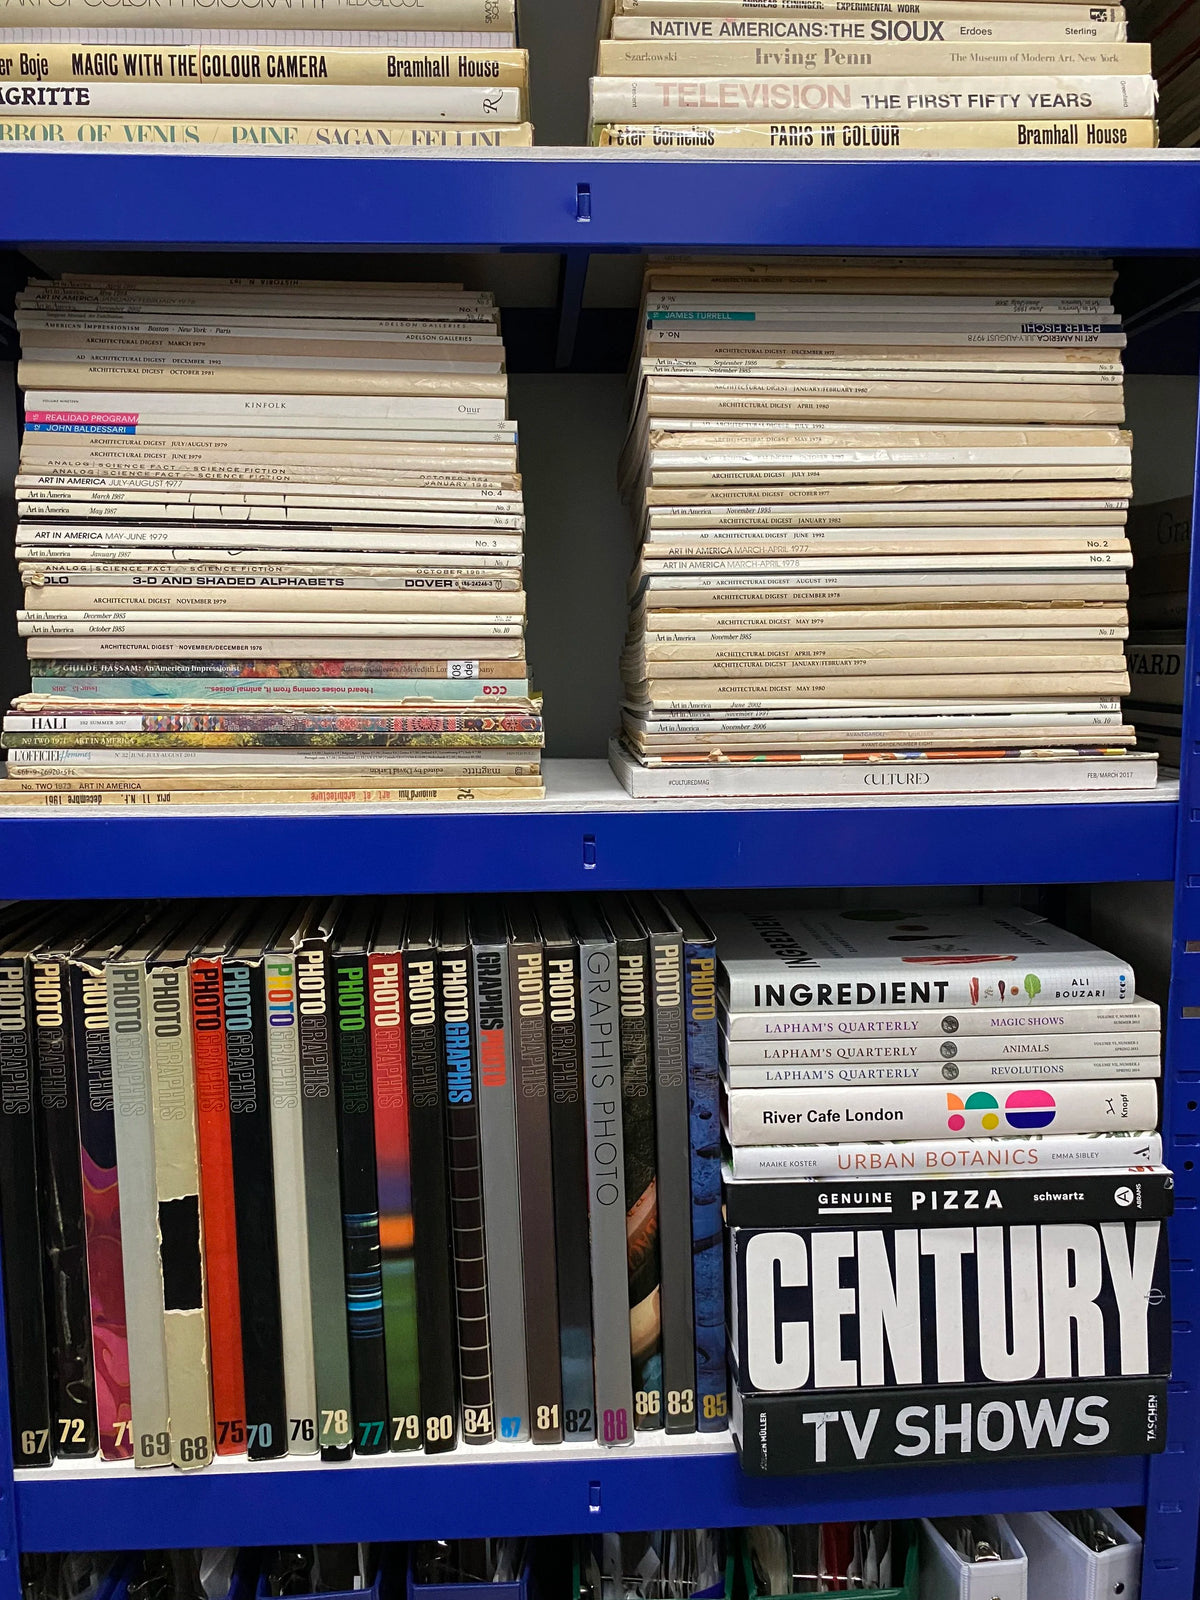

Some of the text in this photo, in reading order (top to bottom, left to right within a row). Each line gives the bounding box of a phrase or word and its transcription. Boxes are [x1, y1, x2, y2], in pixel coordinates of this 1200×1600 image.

[898, 4, 920, 13] WORK
[650, 21, 712, 36] NATIVE
[871, 20, 944, 41] SIOUX
[960, 27, 992, 36] Erdoes
[1065, 28, 1097, 37] Sterling
[20, 53, 499, 81] Boje MAGIC WITH THE COLOUR CAMERA Bramhall House
[625, 52, 677, 61] Szarkowski
[755, 48, 816, 69] Irving
[825, 48, 871, 65] Penn
[950, 53, 967, 62] The
[970, 53, 1007, 62] Museum
[1010, 53, 1018, 62] of
[1021, 54, 1055, 62] Modern
[1078, 54, 1096, 62] New
[1100, 54, 1118, 63] York
[656, 83, 1092, 109] TELEVISION THE FIRST FIFTY YEARS
[78, 125, 111, 142] OF
[770, 125, 1127, 146] PARIS IN COLOUR Bramhall House
[46, 414, 89, 422] REALIDAD
[458, 405, 480, 415] Ouur
[162, 577, 192, 585] AND
[197, 577, 255, 585] SHADED
[260, 578, 344, 586] ALPHABETS
[405, 579, 452, 587] DOVER
[483, 686, 507, 694] CCQ
[32, 718, 66, 729] HALI
[658, 724, 667, 732] Art
[669, 724, 674, 732] in
[676, 724, 699, 732] America
[864, 773, 930, 785] CULTURED
[1072, 978, 1089, 986] ALI
[755, 982, 949, 1006] INGREDIENT
[839, 1021, 918, 1033] QUARTERLY
[991, 1018, 1025, 1026] MAGIC
[1028, 1017, 1064, 1025] SHOWS
[837, 1047, 917, 1059] QUARTERLY
[1003, 1045, 1049, 1053] ANIMALS
[588, 952, 619, 1205] GRAPHIS PHOTO
[839, 1069, 919, 1081] QUARTERLY
[992, 1066, 1064, 1075] REVOLUTIONS
[764, 1109, 903, 1124] River Cafe London
[838, 1153, 914, 1169] URBAN
[926, 1149, 1038, 1168] BOTANICS
[818, 1190, 1084, 1210] GENUINE PIZZA schwartz
[746, 1221, 1161, 1390] CENTURY
[636, 1391, 659, 1414] 86
[668, 1390, 693, 1414] 83
[703, 1393, 726, 1418] 85
[321, 1410, 348, 1434] 78
[393, 1415, 419, 1440] 79
[427, 1415, 452, 1441] 80
[465, 1408, 491, 1433] 84
[501, 1417, 520, 1437] 87
[538, 1404, 558, 1429] 81
[566, 1410, 591, 1432] 82
[604, 1409, 627, 1441] 88
[1147, 1394, 1157, 1441] TASCHEN
[59, 1419, 85, 1443] 72
[218, 1420, 244, 1444] 75
[248, 1424, 272, 1447] 70
[290, 1419, 314, 1440] 76
[359, 1422, 384, 1445] 77
[803, 1409, 880, 1462] TV
[895, 1396, 1109, 1457] SHOWS
[22, 1430, 48, 1454] 67
[141, 1433, 169, 1457] 69
[180, 1436, 207, 1461] 68
